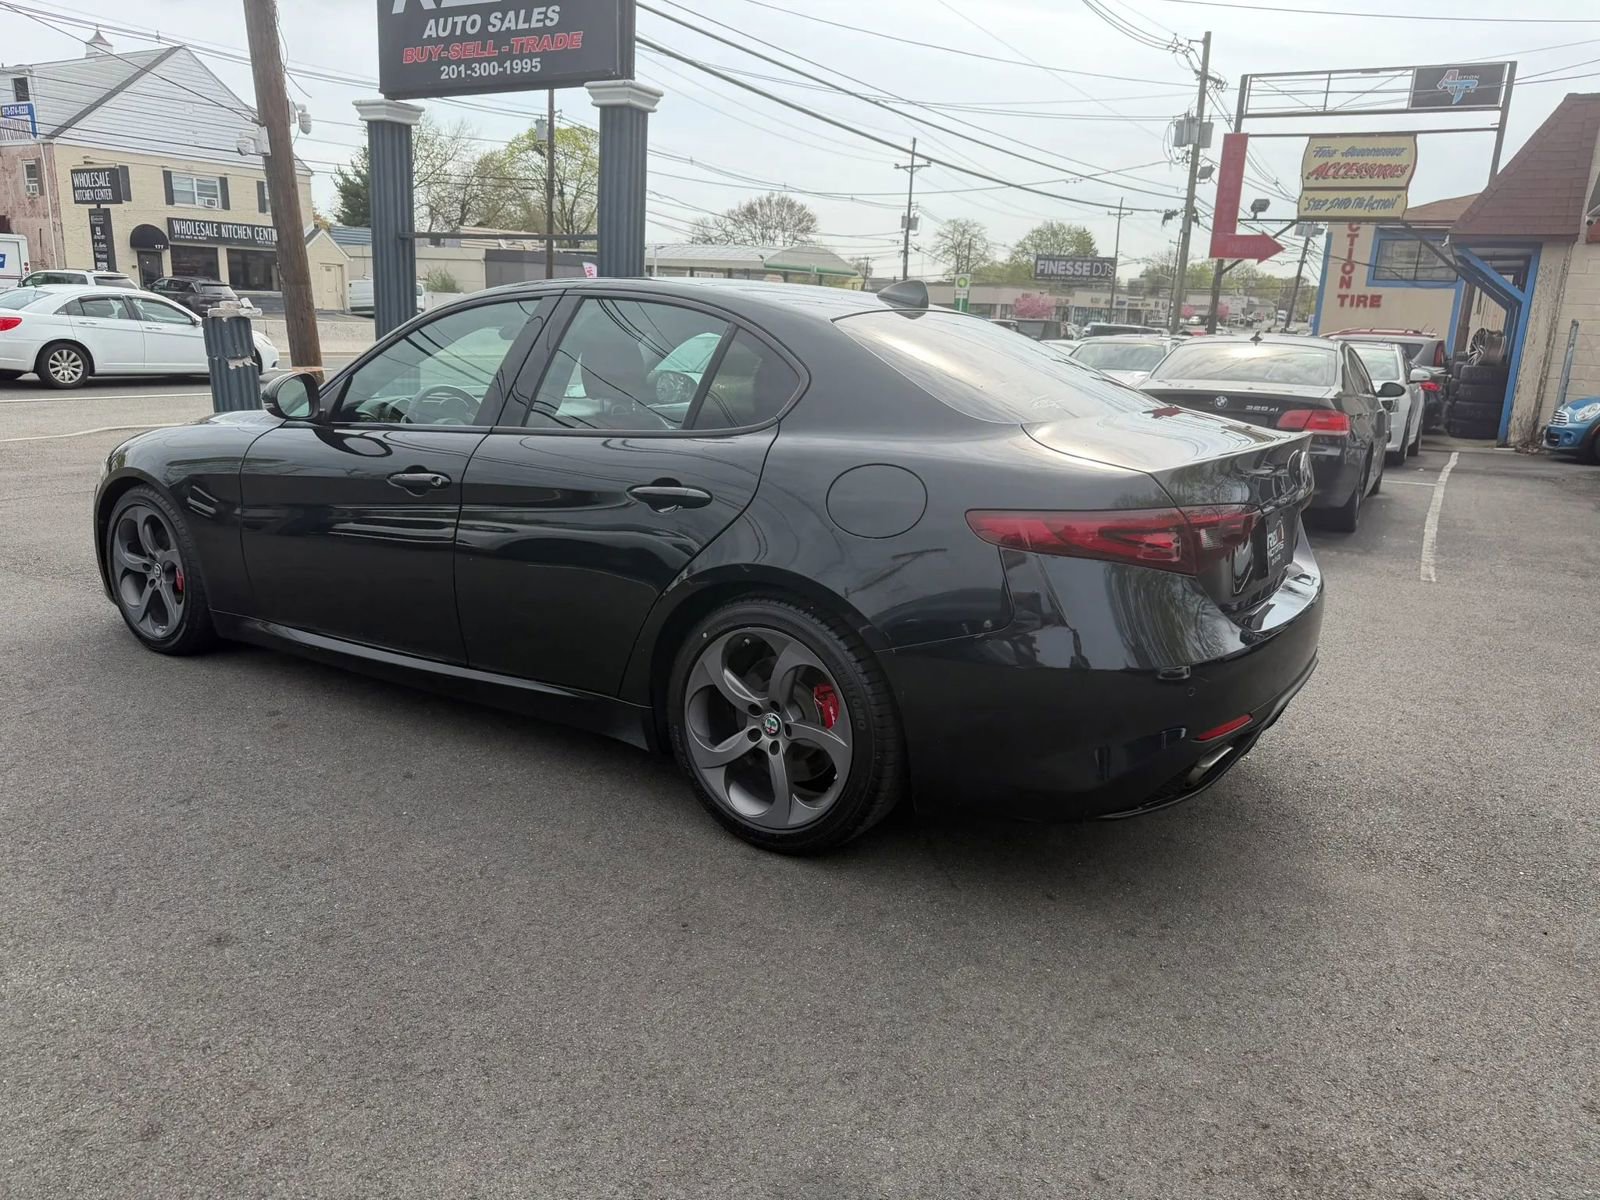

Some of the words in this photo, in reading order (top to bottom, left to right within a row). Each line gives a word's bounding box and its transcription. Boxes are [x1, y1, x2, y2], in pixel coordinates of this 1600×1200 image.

[423, 14, 481, 39] AUTO
[488, 6, 560, 33] SALES
[440, 58, 541, 80] 201-300-1995
[72, 172, 111, 187] WHOLESALE
[1306, 162, 1410, 180] ACCESSORIES
[75, 189, 94, 201] KITCHEN
[95, 188, 113, 201] CENTER
[173, 220, 219, 237] WHOLESALE
[221, 224, 253, 240] KITCHEN
[1036, 260, 1091, 276] FINESSE
[1337, 294, 1383, 308] TIRE
